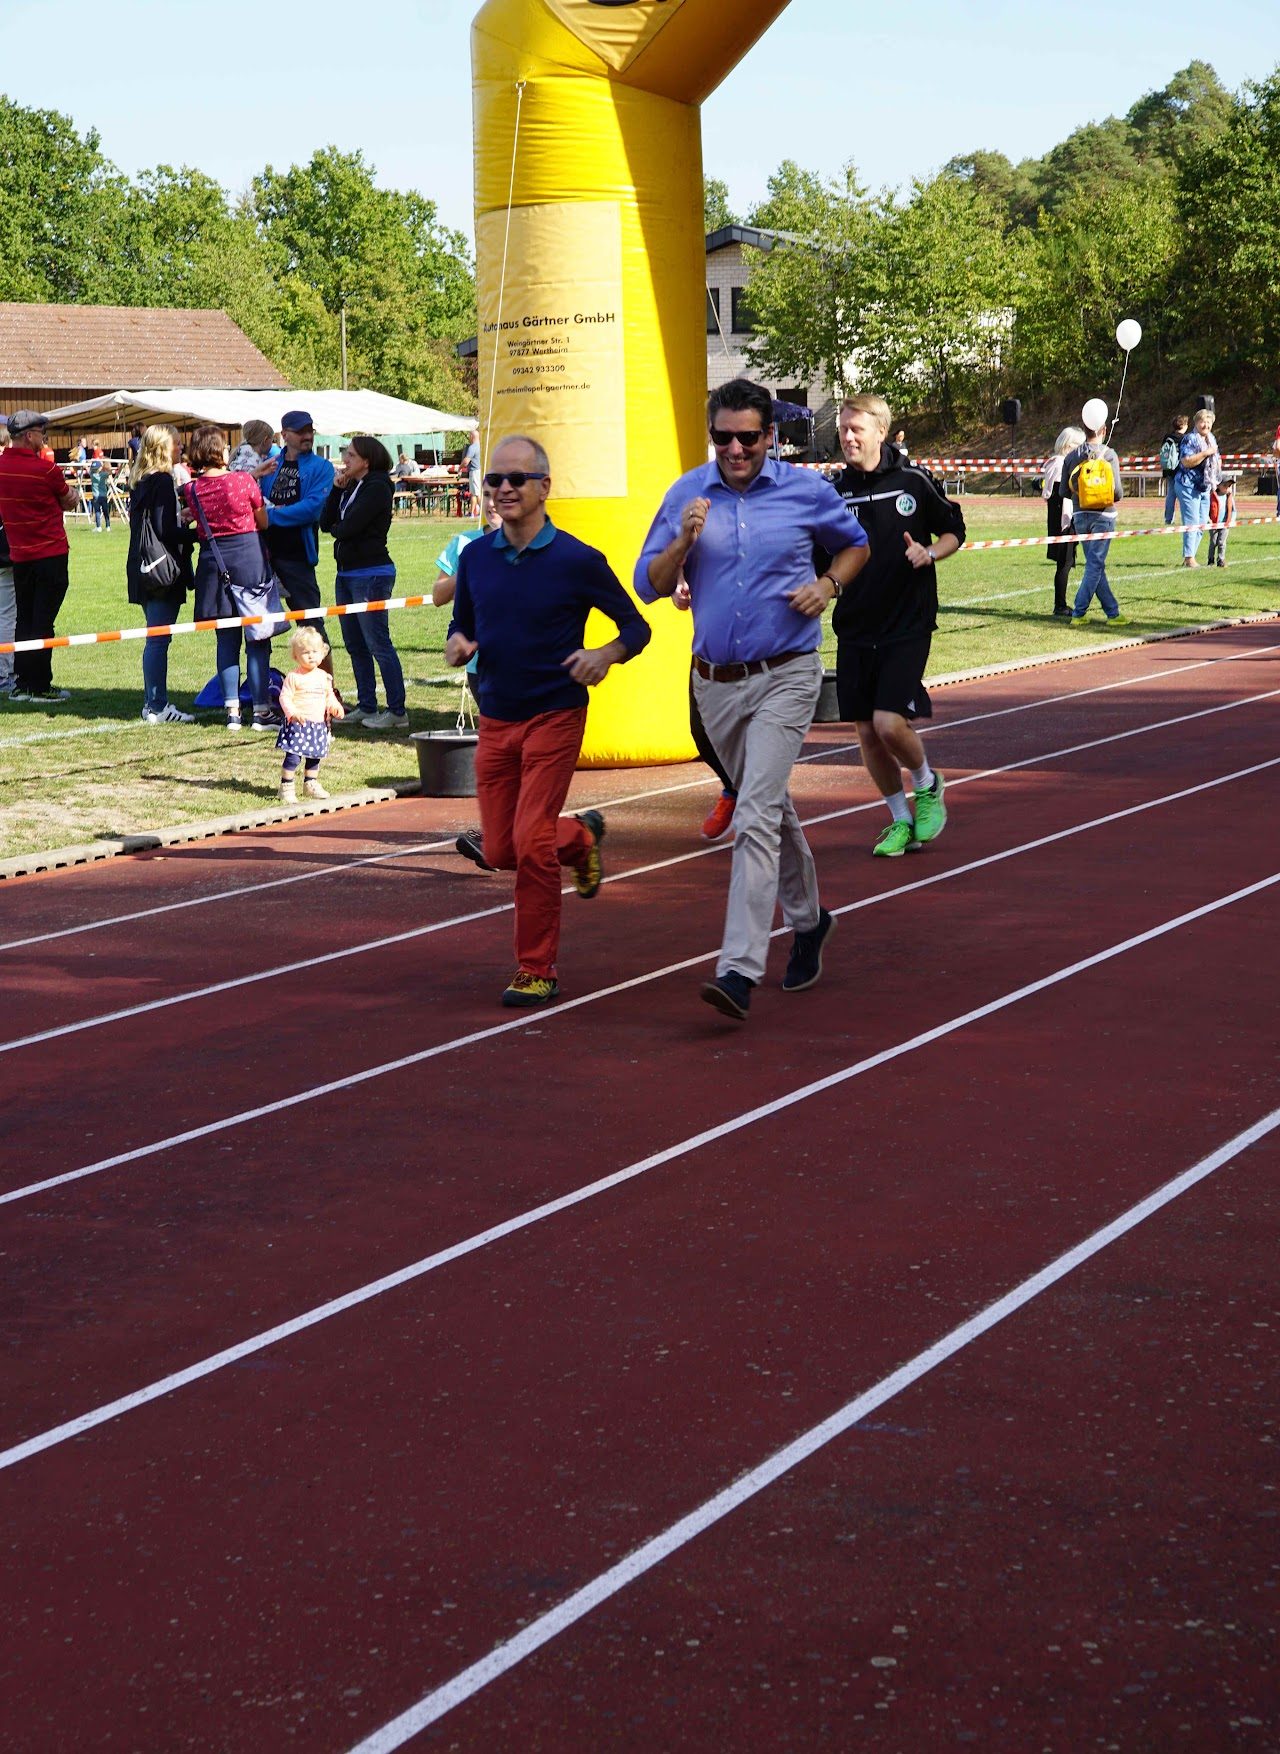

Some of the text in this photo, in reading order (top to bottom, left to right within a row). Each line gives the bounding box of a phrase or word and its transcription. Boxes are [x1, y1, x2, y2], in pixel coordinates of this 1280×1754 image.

[522, 315, 569, 327] Gärtner
[573, 312, 615, 324] GmbH
[551, 337, 563, 345] Str.
[509, 346, 568, 357] 97877 Wertheim
[512, 364, 566, 375] 09342 933300
